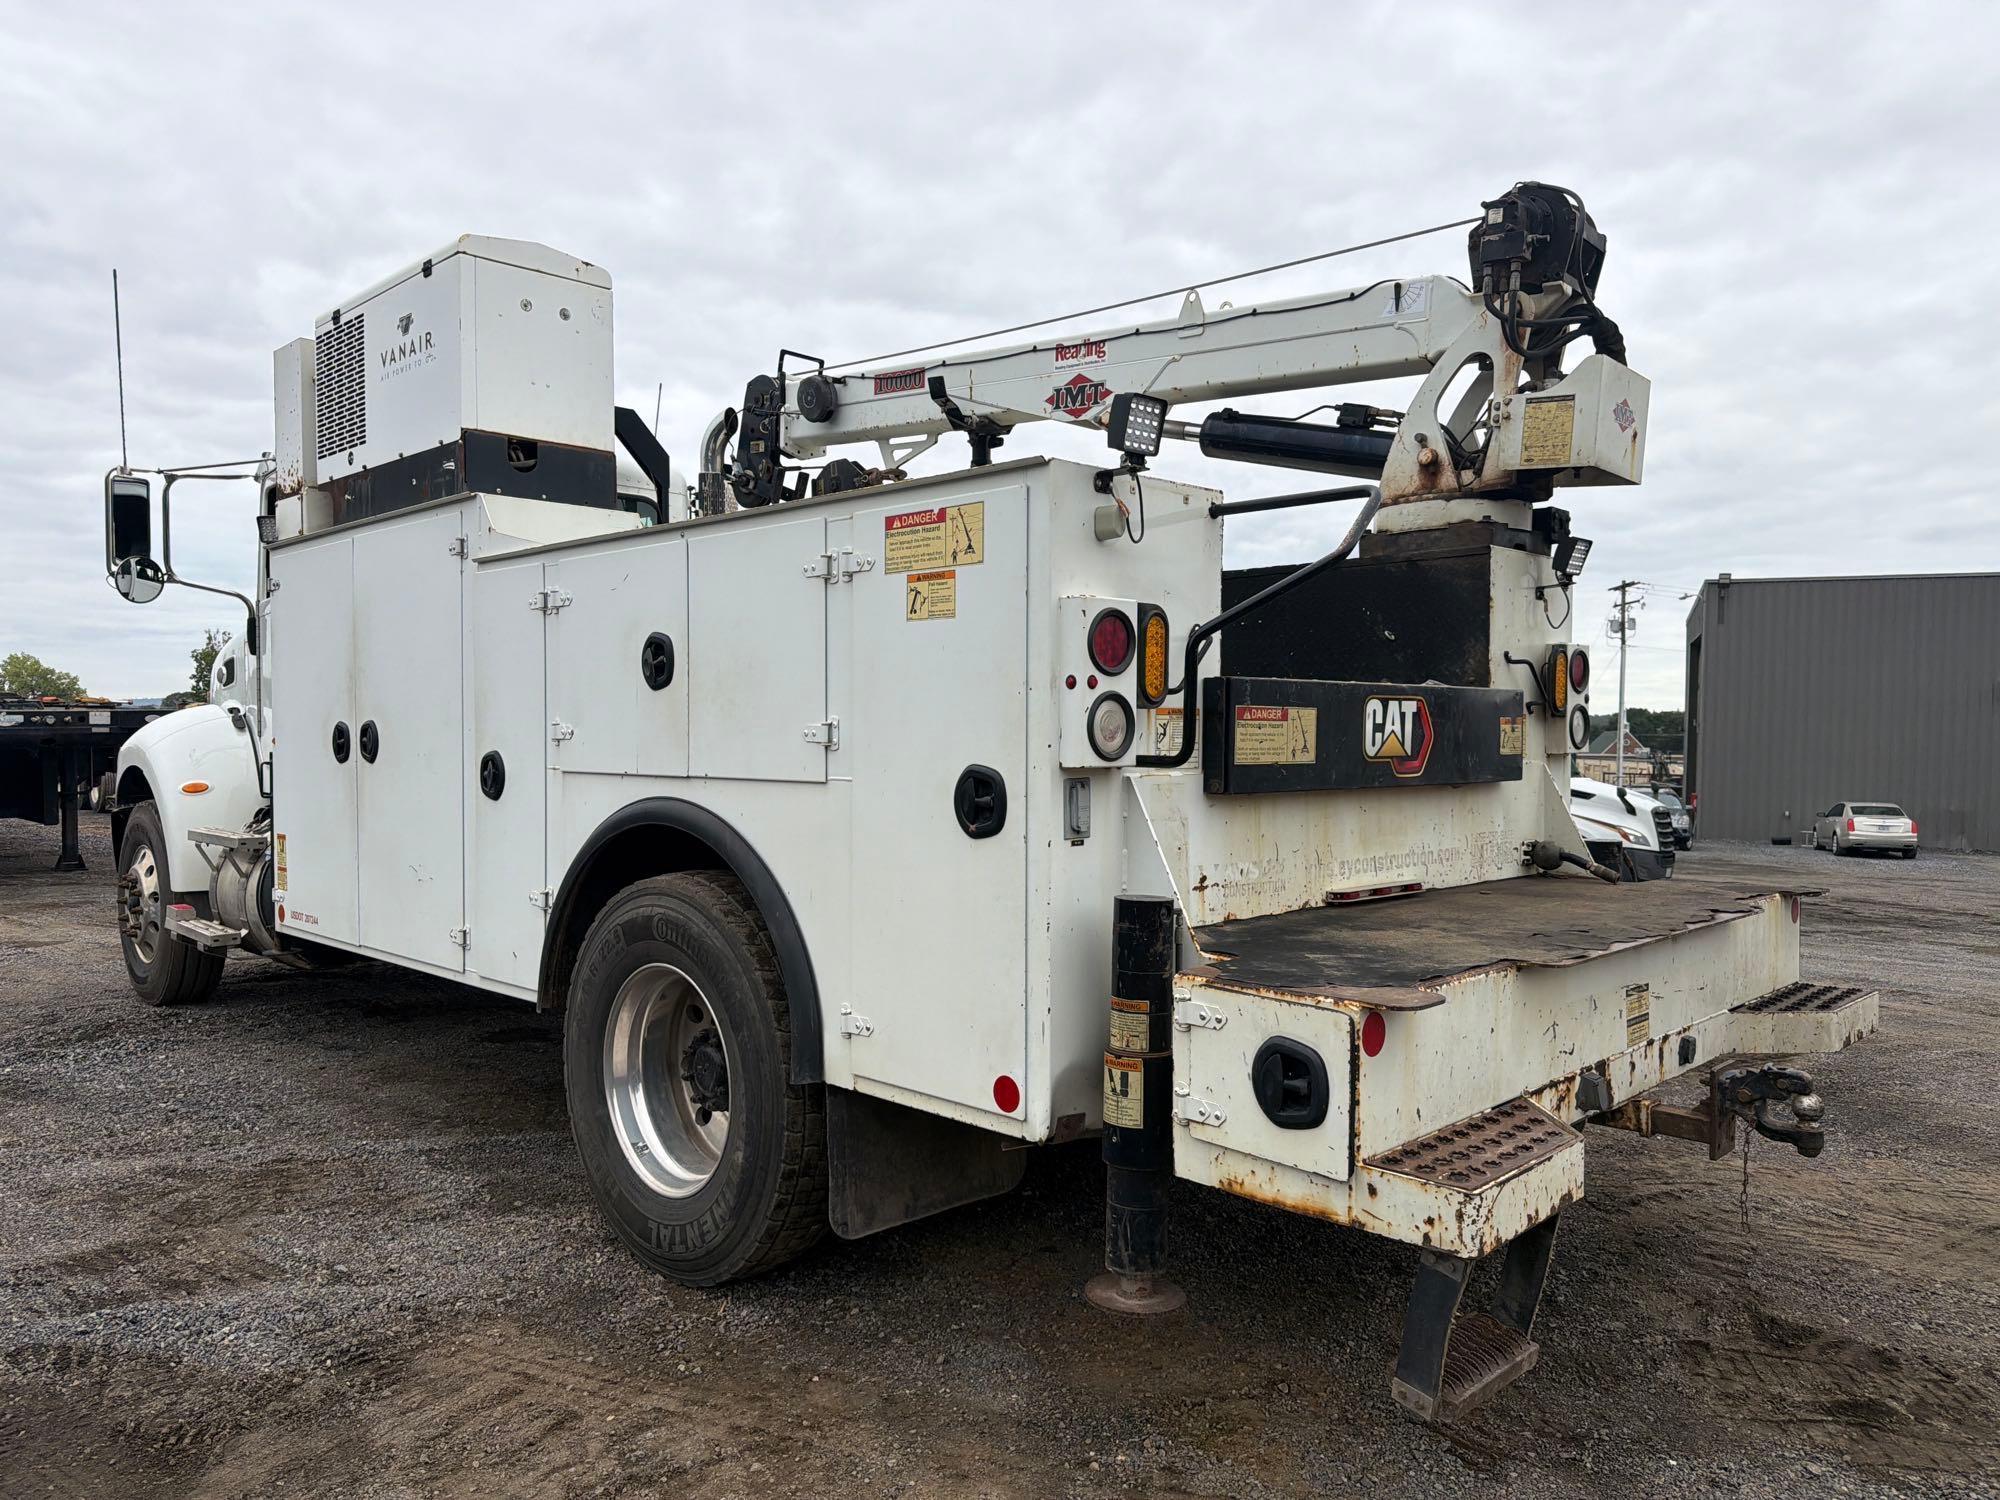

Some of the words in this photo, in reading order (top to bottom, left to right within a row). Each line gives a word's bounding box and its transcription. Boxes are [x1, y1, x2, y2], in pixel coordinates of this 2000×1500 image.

[380, 331, 433, 369] VANAIR
[1053, 382, 1106, 410] IMT
[901, 511, 938, 526] DANGER
[1251, 708, 1282, 719] DANGER
[1364, 698, 1418, 757] CAT
